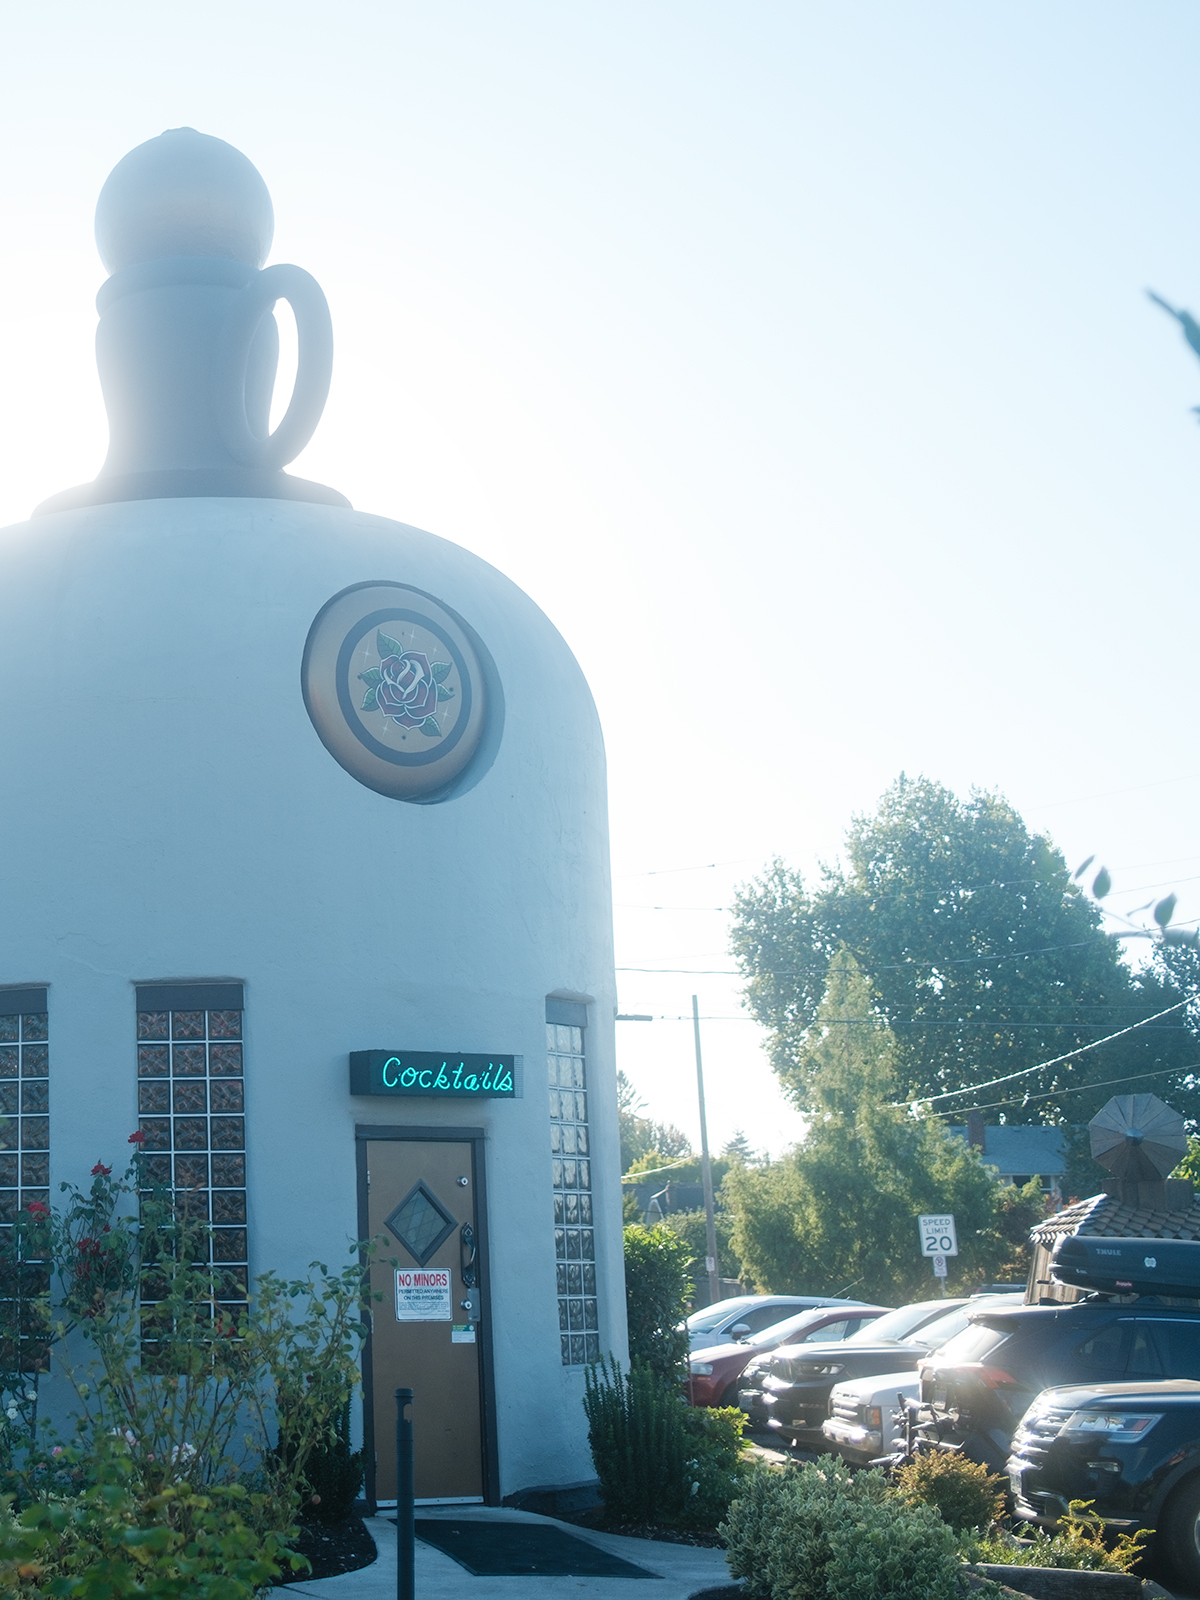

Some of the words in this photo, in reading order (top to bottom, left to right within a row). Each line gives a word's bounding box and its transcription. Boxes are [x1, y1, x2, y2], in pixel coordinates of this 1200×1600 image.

[382, 1056, 513, 1091] Cocktails
[922, 1218, 951, 1226] SPEED
[925, 1235, 952, 1252] 20
[1095, 1248, 1122, 1256] THULE
[398, 1274, 412, 1287] NO
[413, 1274, 448, 1287] MINORS
